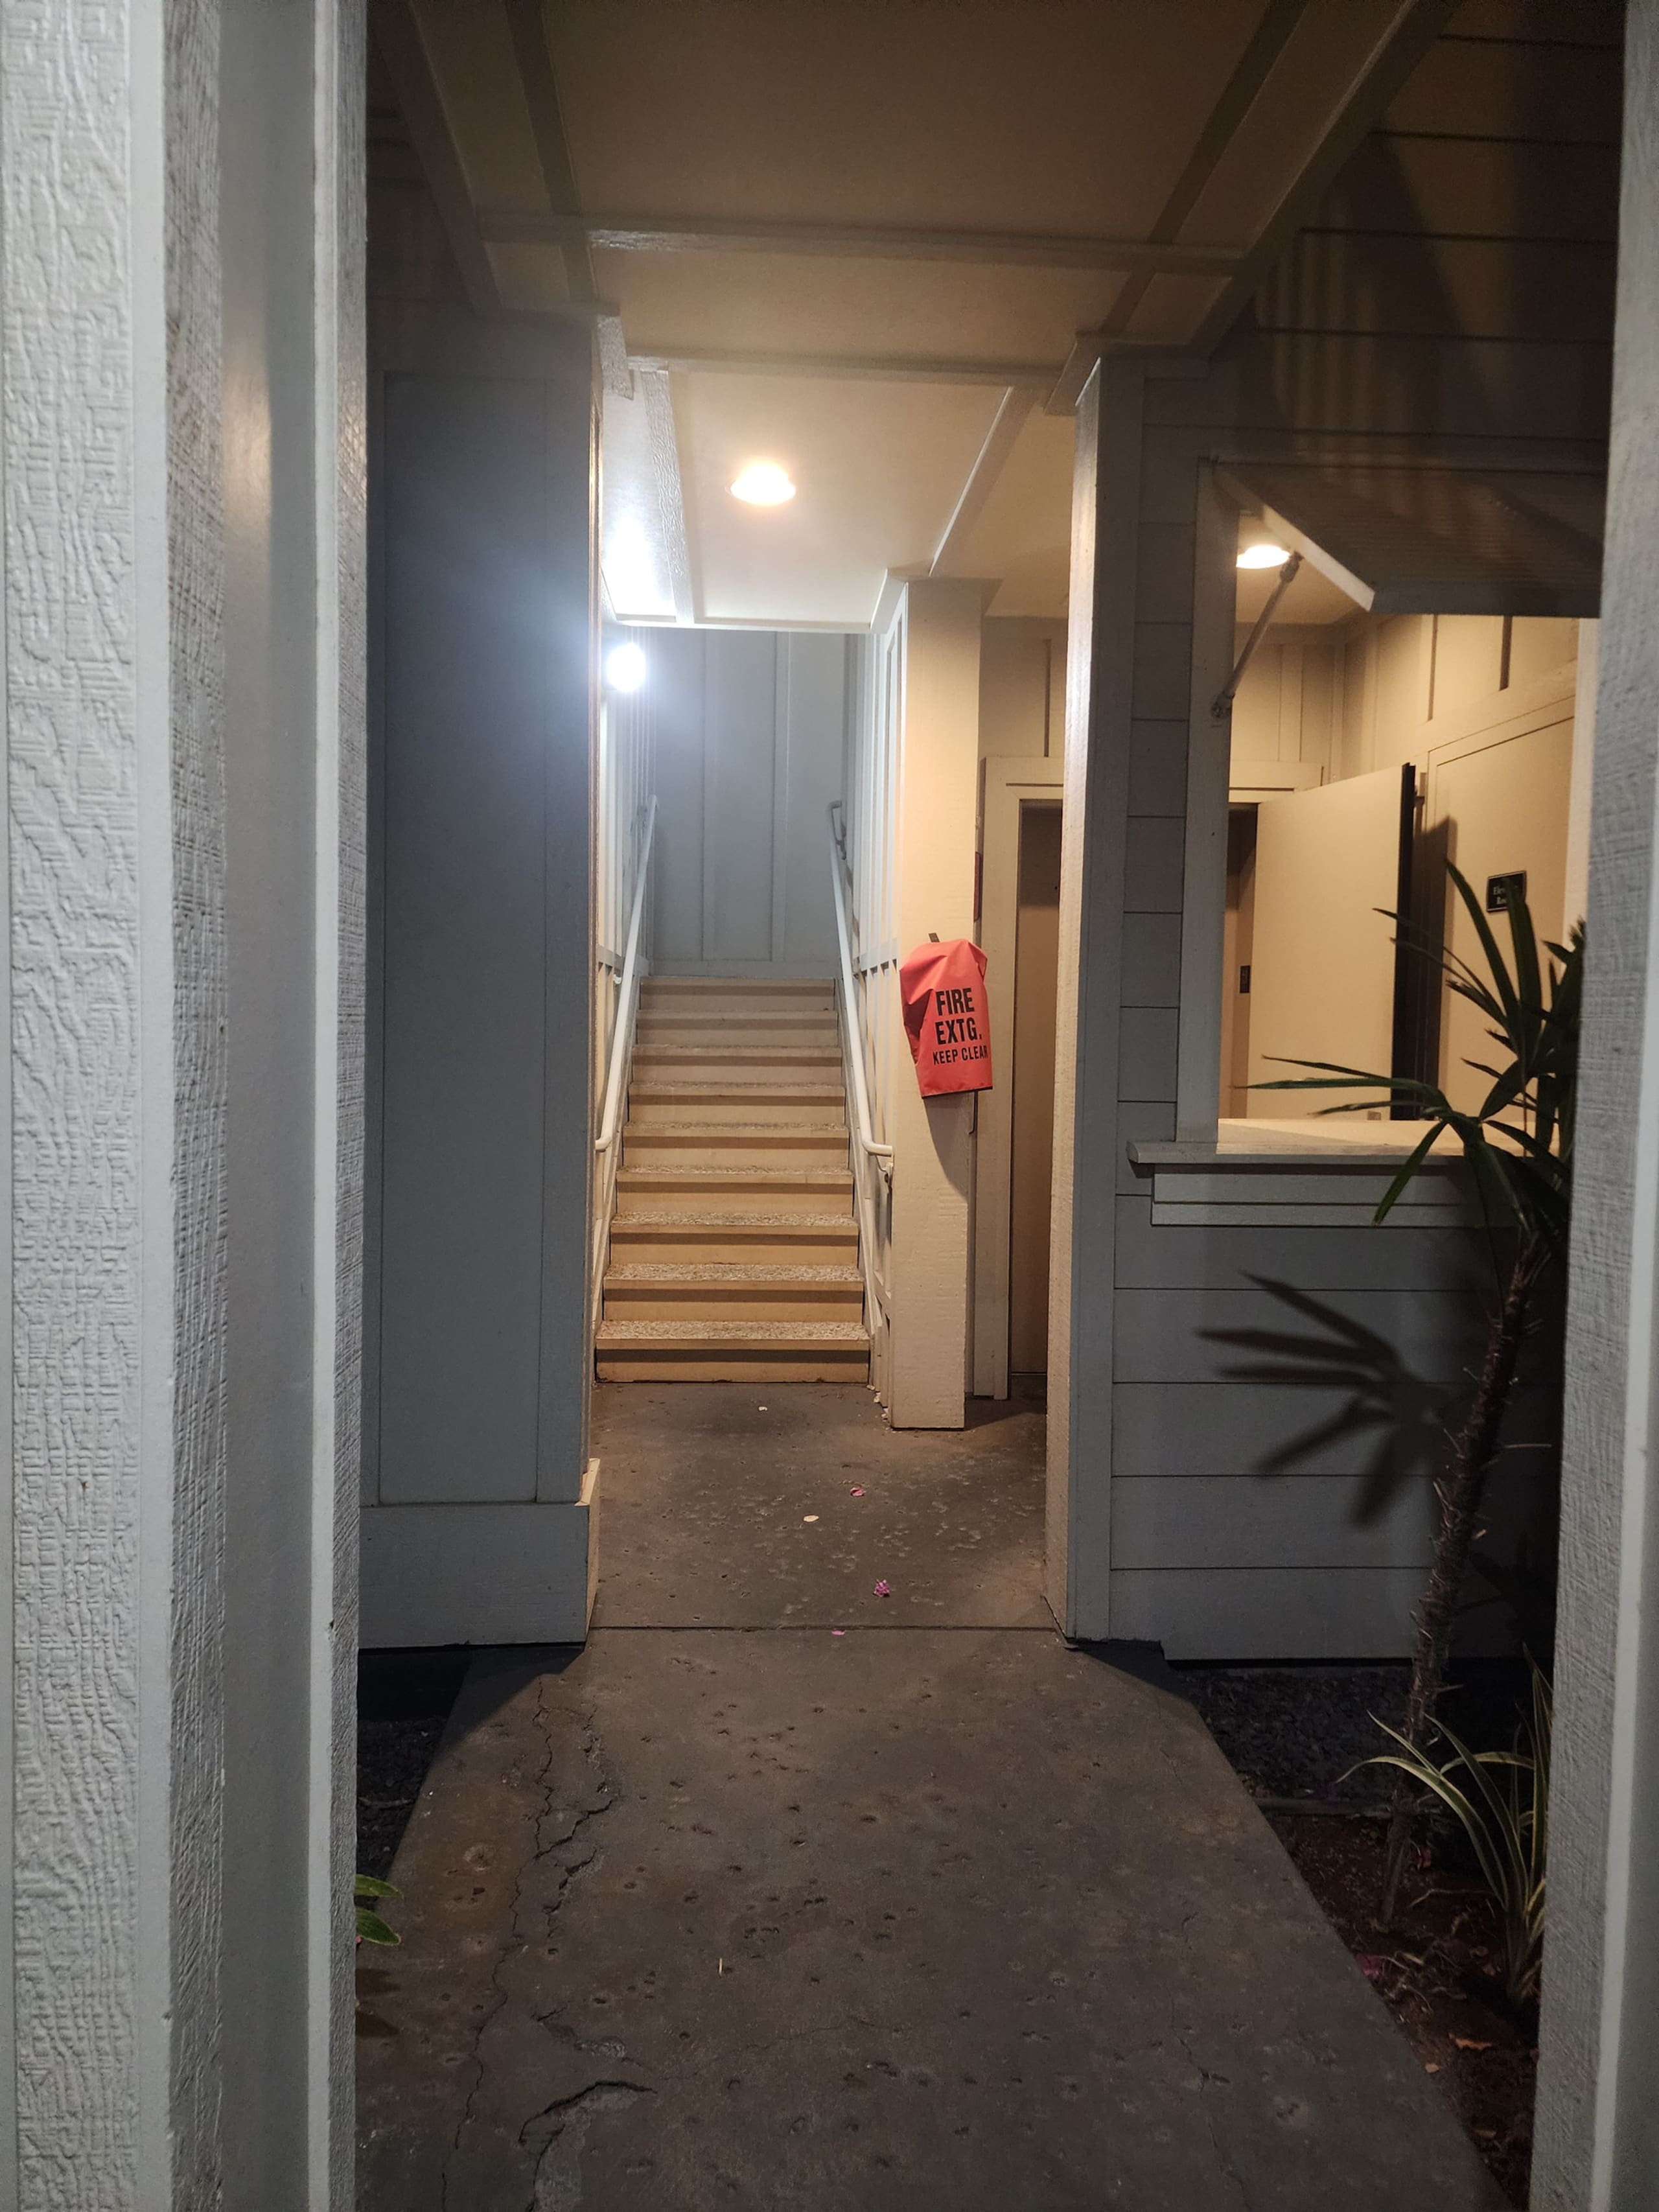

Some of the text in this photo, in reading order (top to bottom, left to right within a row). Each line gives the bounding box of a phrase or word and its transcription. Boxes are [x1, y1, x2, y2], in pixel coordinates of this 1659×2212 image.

[935, 987, 975, 1016] FIRE
[935, 1017, 982, 1045] EXTG.
[933, 1045, 988, 1065] KEEP CLEAR
